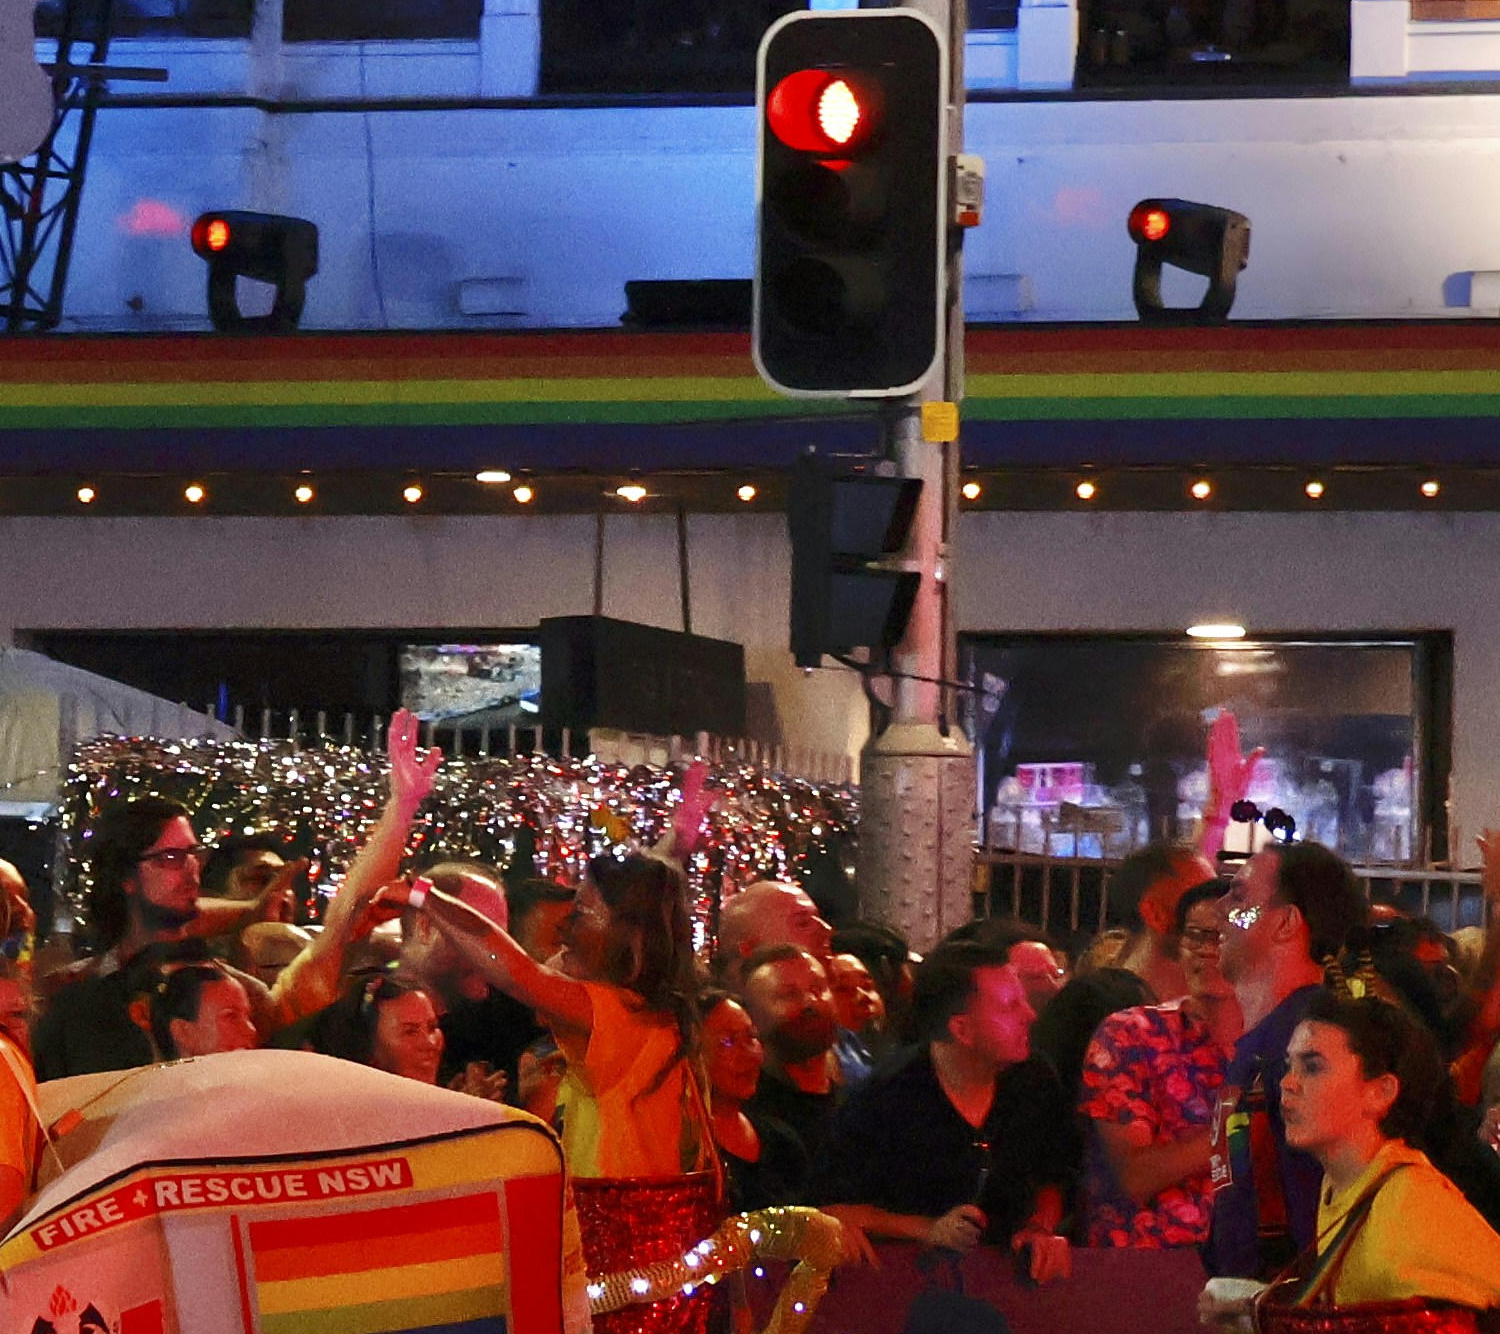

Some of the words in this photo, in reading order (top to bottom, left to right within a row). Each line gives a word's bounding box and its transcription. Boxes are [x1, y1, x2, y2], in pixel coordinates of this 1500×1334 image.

[38, 1196, 125, 1247] FIRE
[154, 1173, 308, 1208] RESCUE
[317, 1162, 404, 1195] NSW
